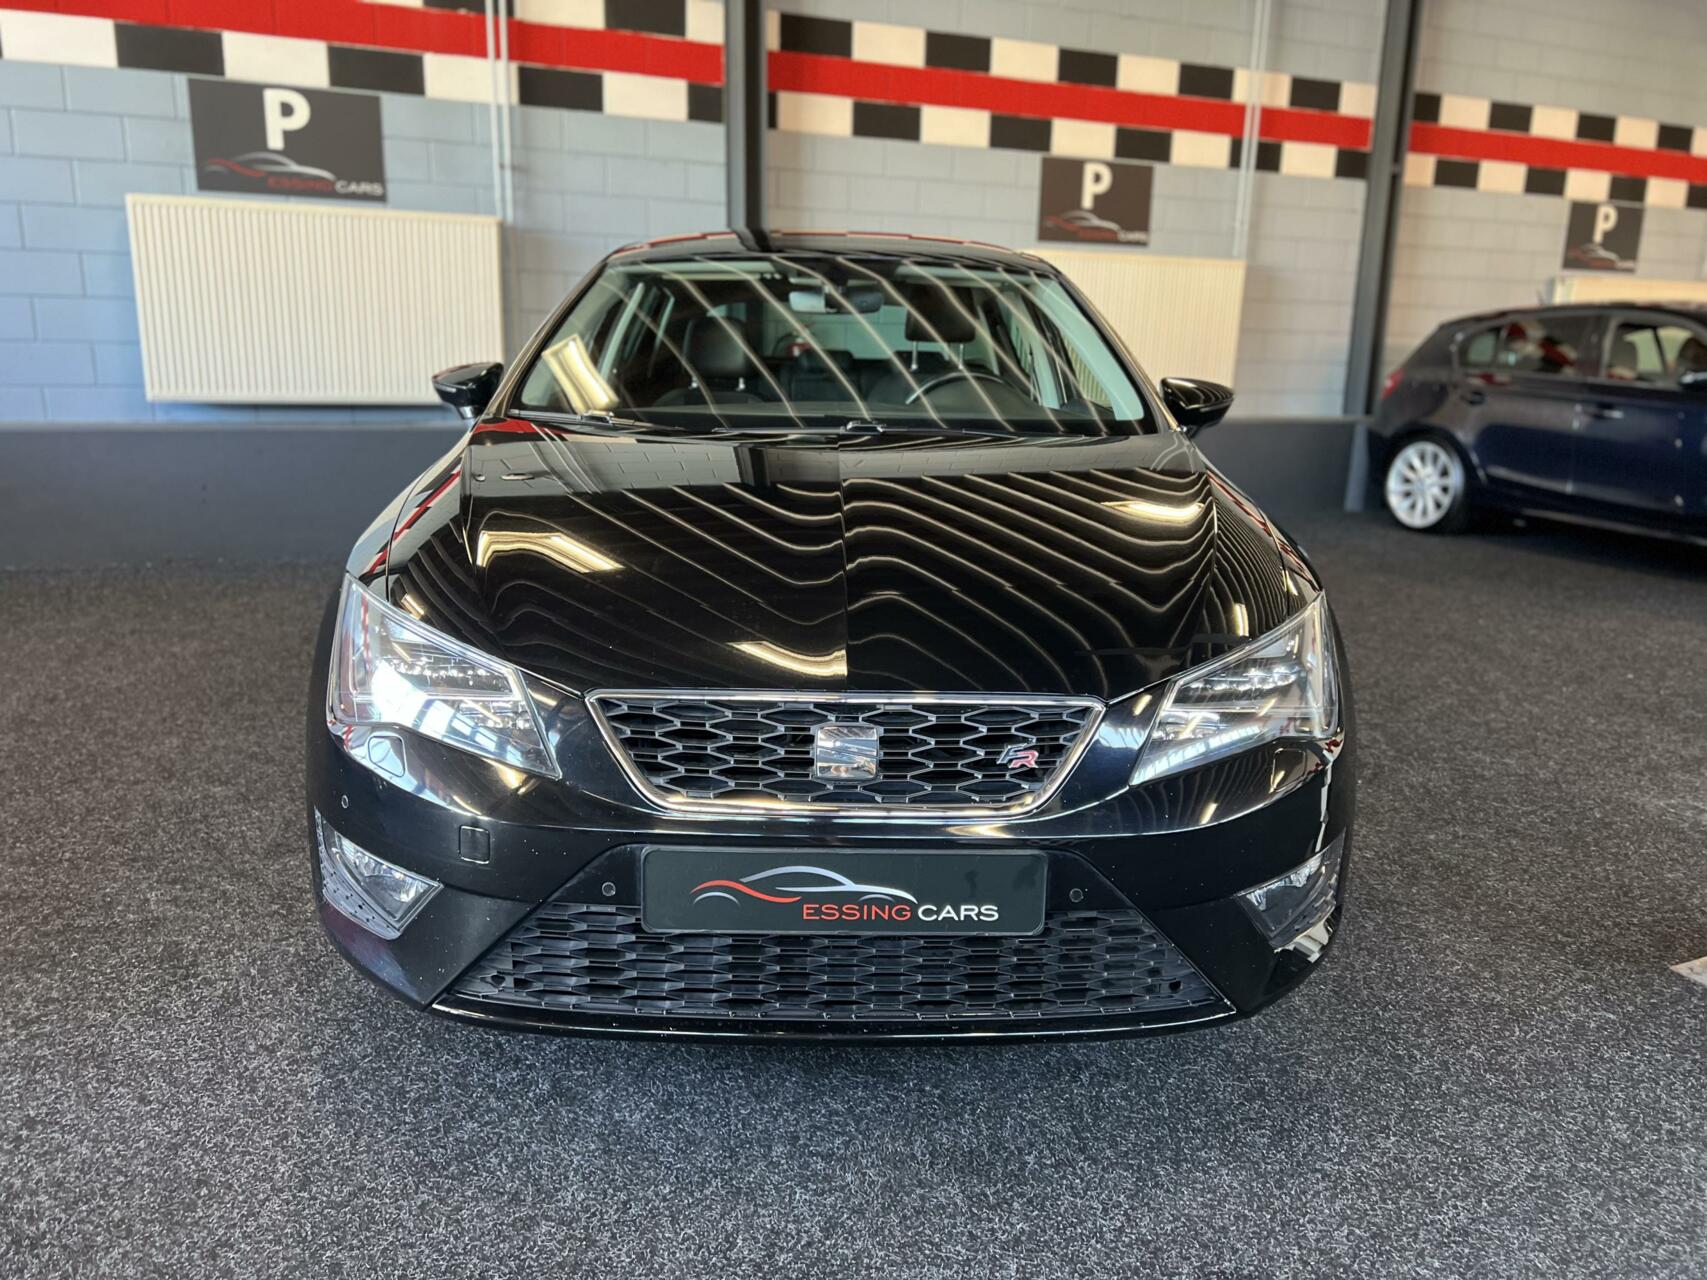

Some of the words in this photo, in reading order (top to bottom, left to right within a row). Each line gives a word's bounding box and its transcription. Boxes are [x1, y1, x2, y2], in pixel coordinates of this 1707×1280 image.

[263, 87, 311, 151] P
[334, 180, 384, 196] CARS
[1081, 161, 1113, 210] P
[1593, 203, 1618, 244] P
[996, 743, 1039, 768] FR
[802, 904, 912, 921] ESSING
[918, 904, 1000, 922] CARS
